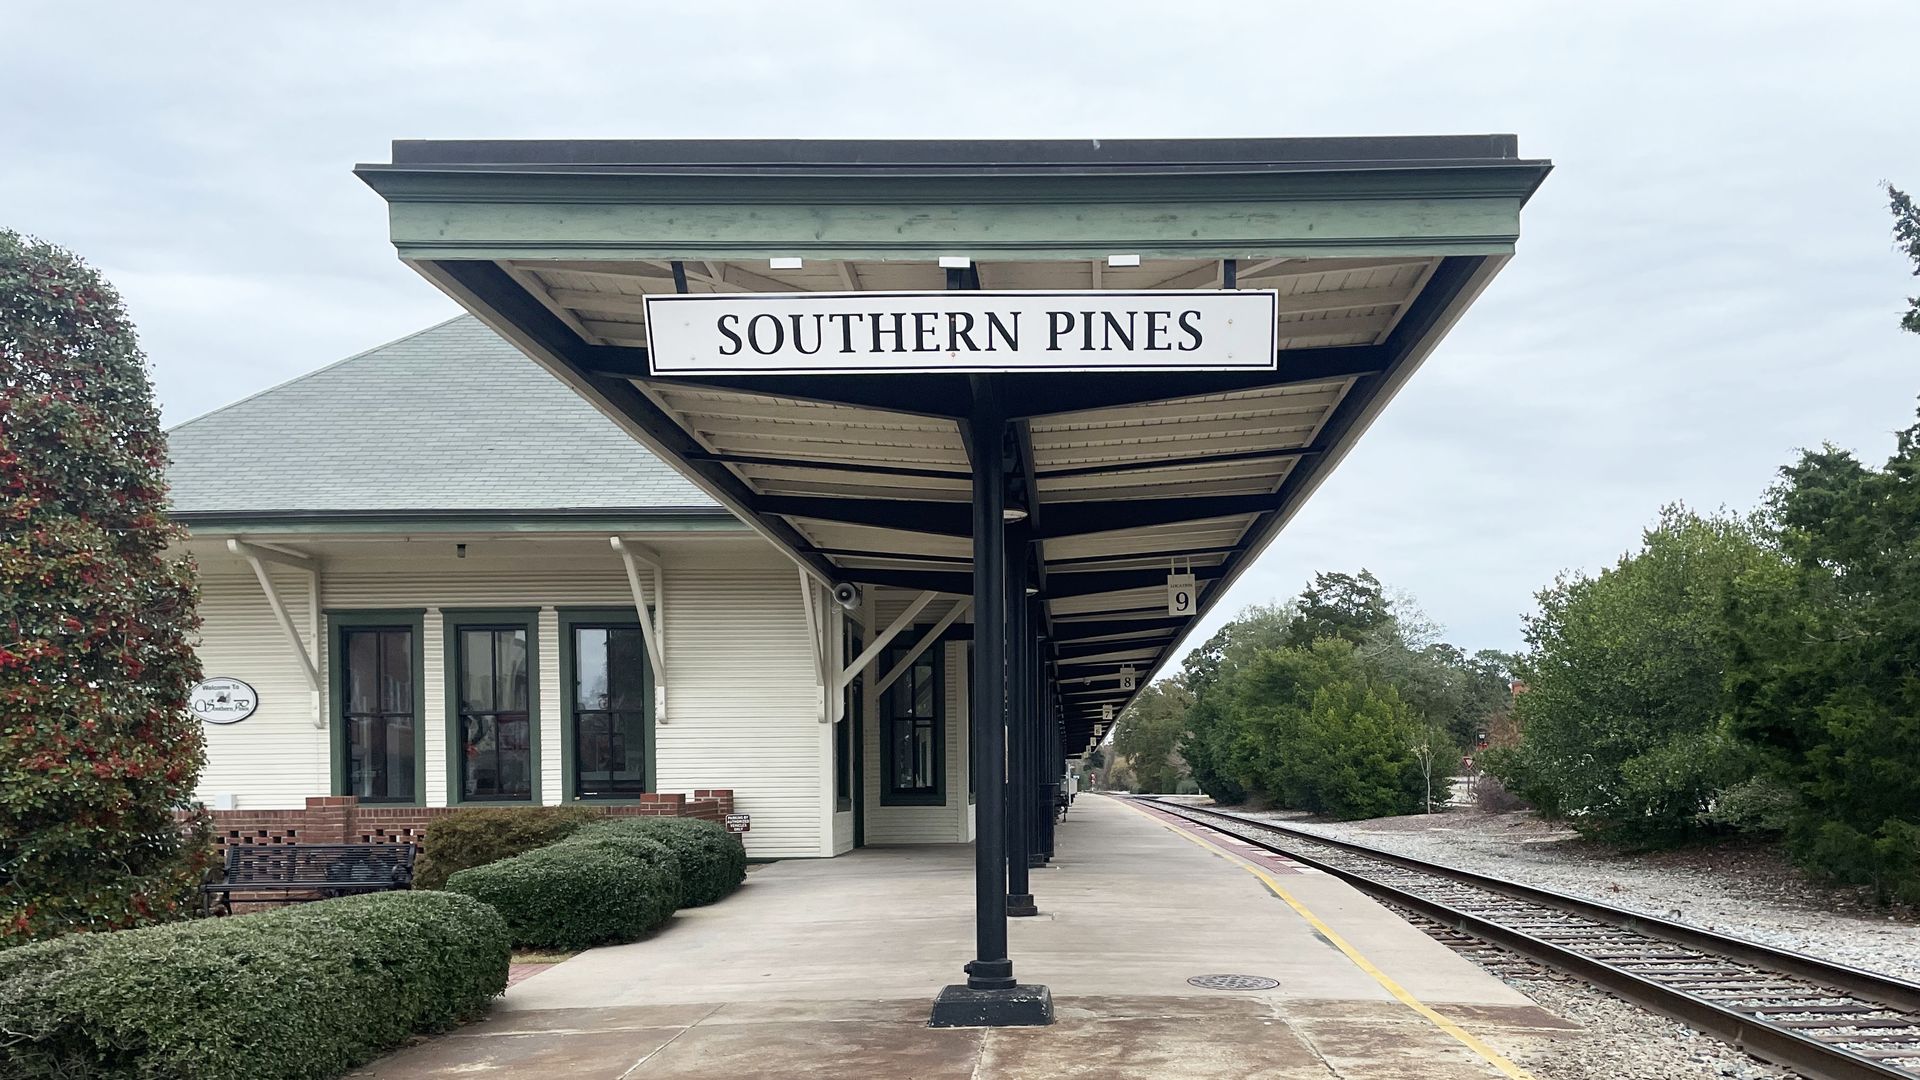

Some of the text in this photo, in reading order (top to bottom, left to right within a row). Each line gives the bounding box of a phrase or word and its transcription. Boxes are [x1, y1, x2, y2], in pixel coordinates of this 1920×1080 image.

[717, 309, 1205, 356] SOUTHERN PINES
[1176, 592, 1189, 612] 9
[1124, 677, 1131, 688] 8
[194, 699, 233, 713] Southern
